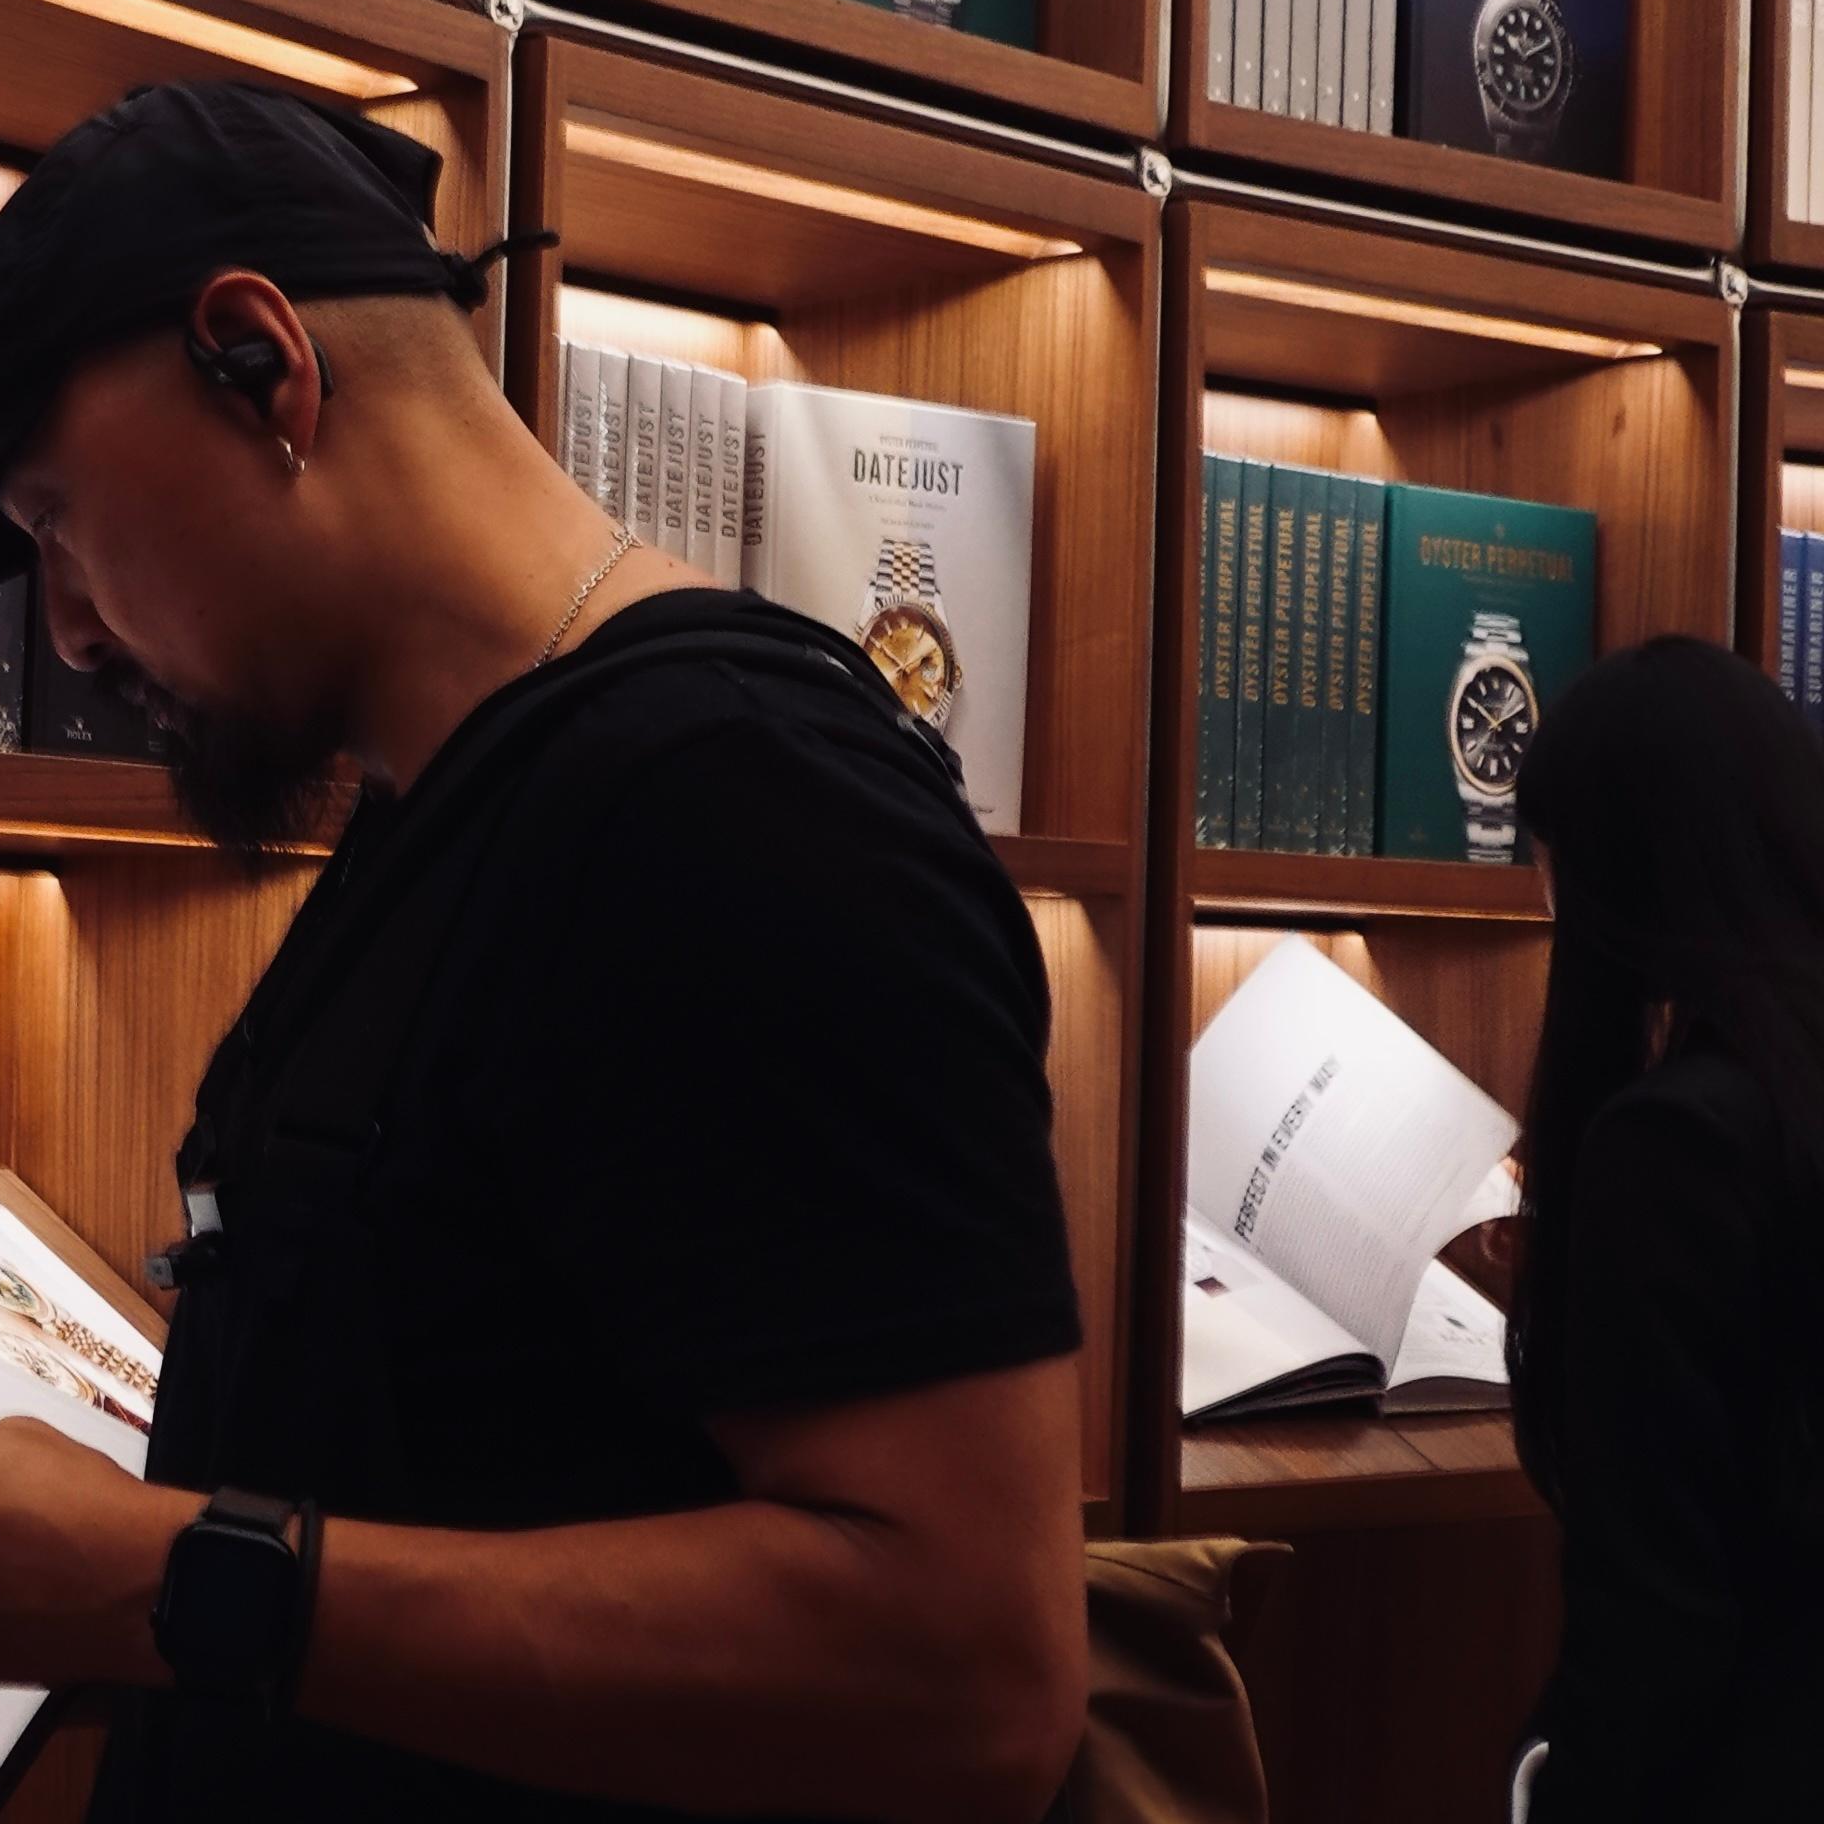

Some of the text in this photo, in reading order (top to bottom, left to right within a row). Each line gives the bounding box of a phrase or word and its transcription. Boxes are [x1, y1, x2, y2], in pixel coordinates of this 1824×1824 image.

[636, 402, 656, 523] DATEJUST
[666, 408, 685, 528] DATEJUST
[696, 414, 714, 533] DATEJUST
[722, 421, 740, 538] DATEJUST
[743, 433, 766, 546] DATEJUST
[854, 448, 964, 496] DATEJUST
[1216, 499, 1235, 699] OYSTER PERPETUAL
[1245, 504, 1264, 702] OYSTER PERPETUAL
[1273, 508, 1294, 705] OYSTER PERPETUAL
[1300, 513, 1322, 708] OYSTER PERPETUAL
[1420, 535, 1481, 571] OYSTER
[1329, 518, 1350, 712] OYSTER PERPETUAL
[1356, 523, 1378, 715] OYSTER PERPETUAL
[66, 728, 92, 742] ROLEX
[1234, 1166, 1269, 1243] PERFECT
[1272, 1091, 1314, 1150] EVERY
